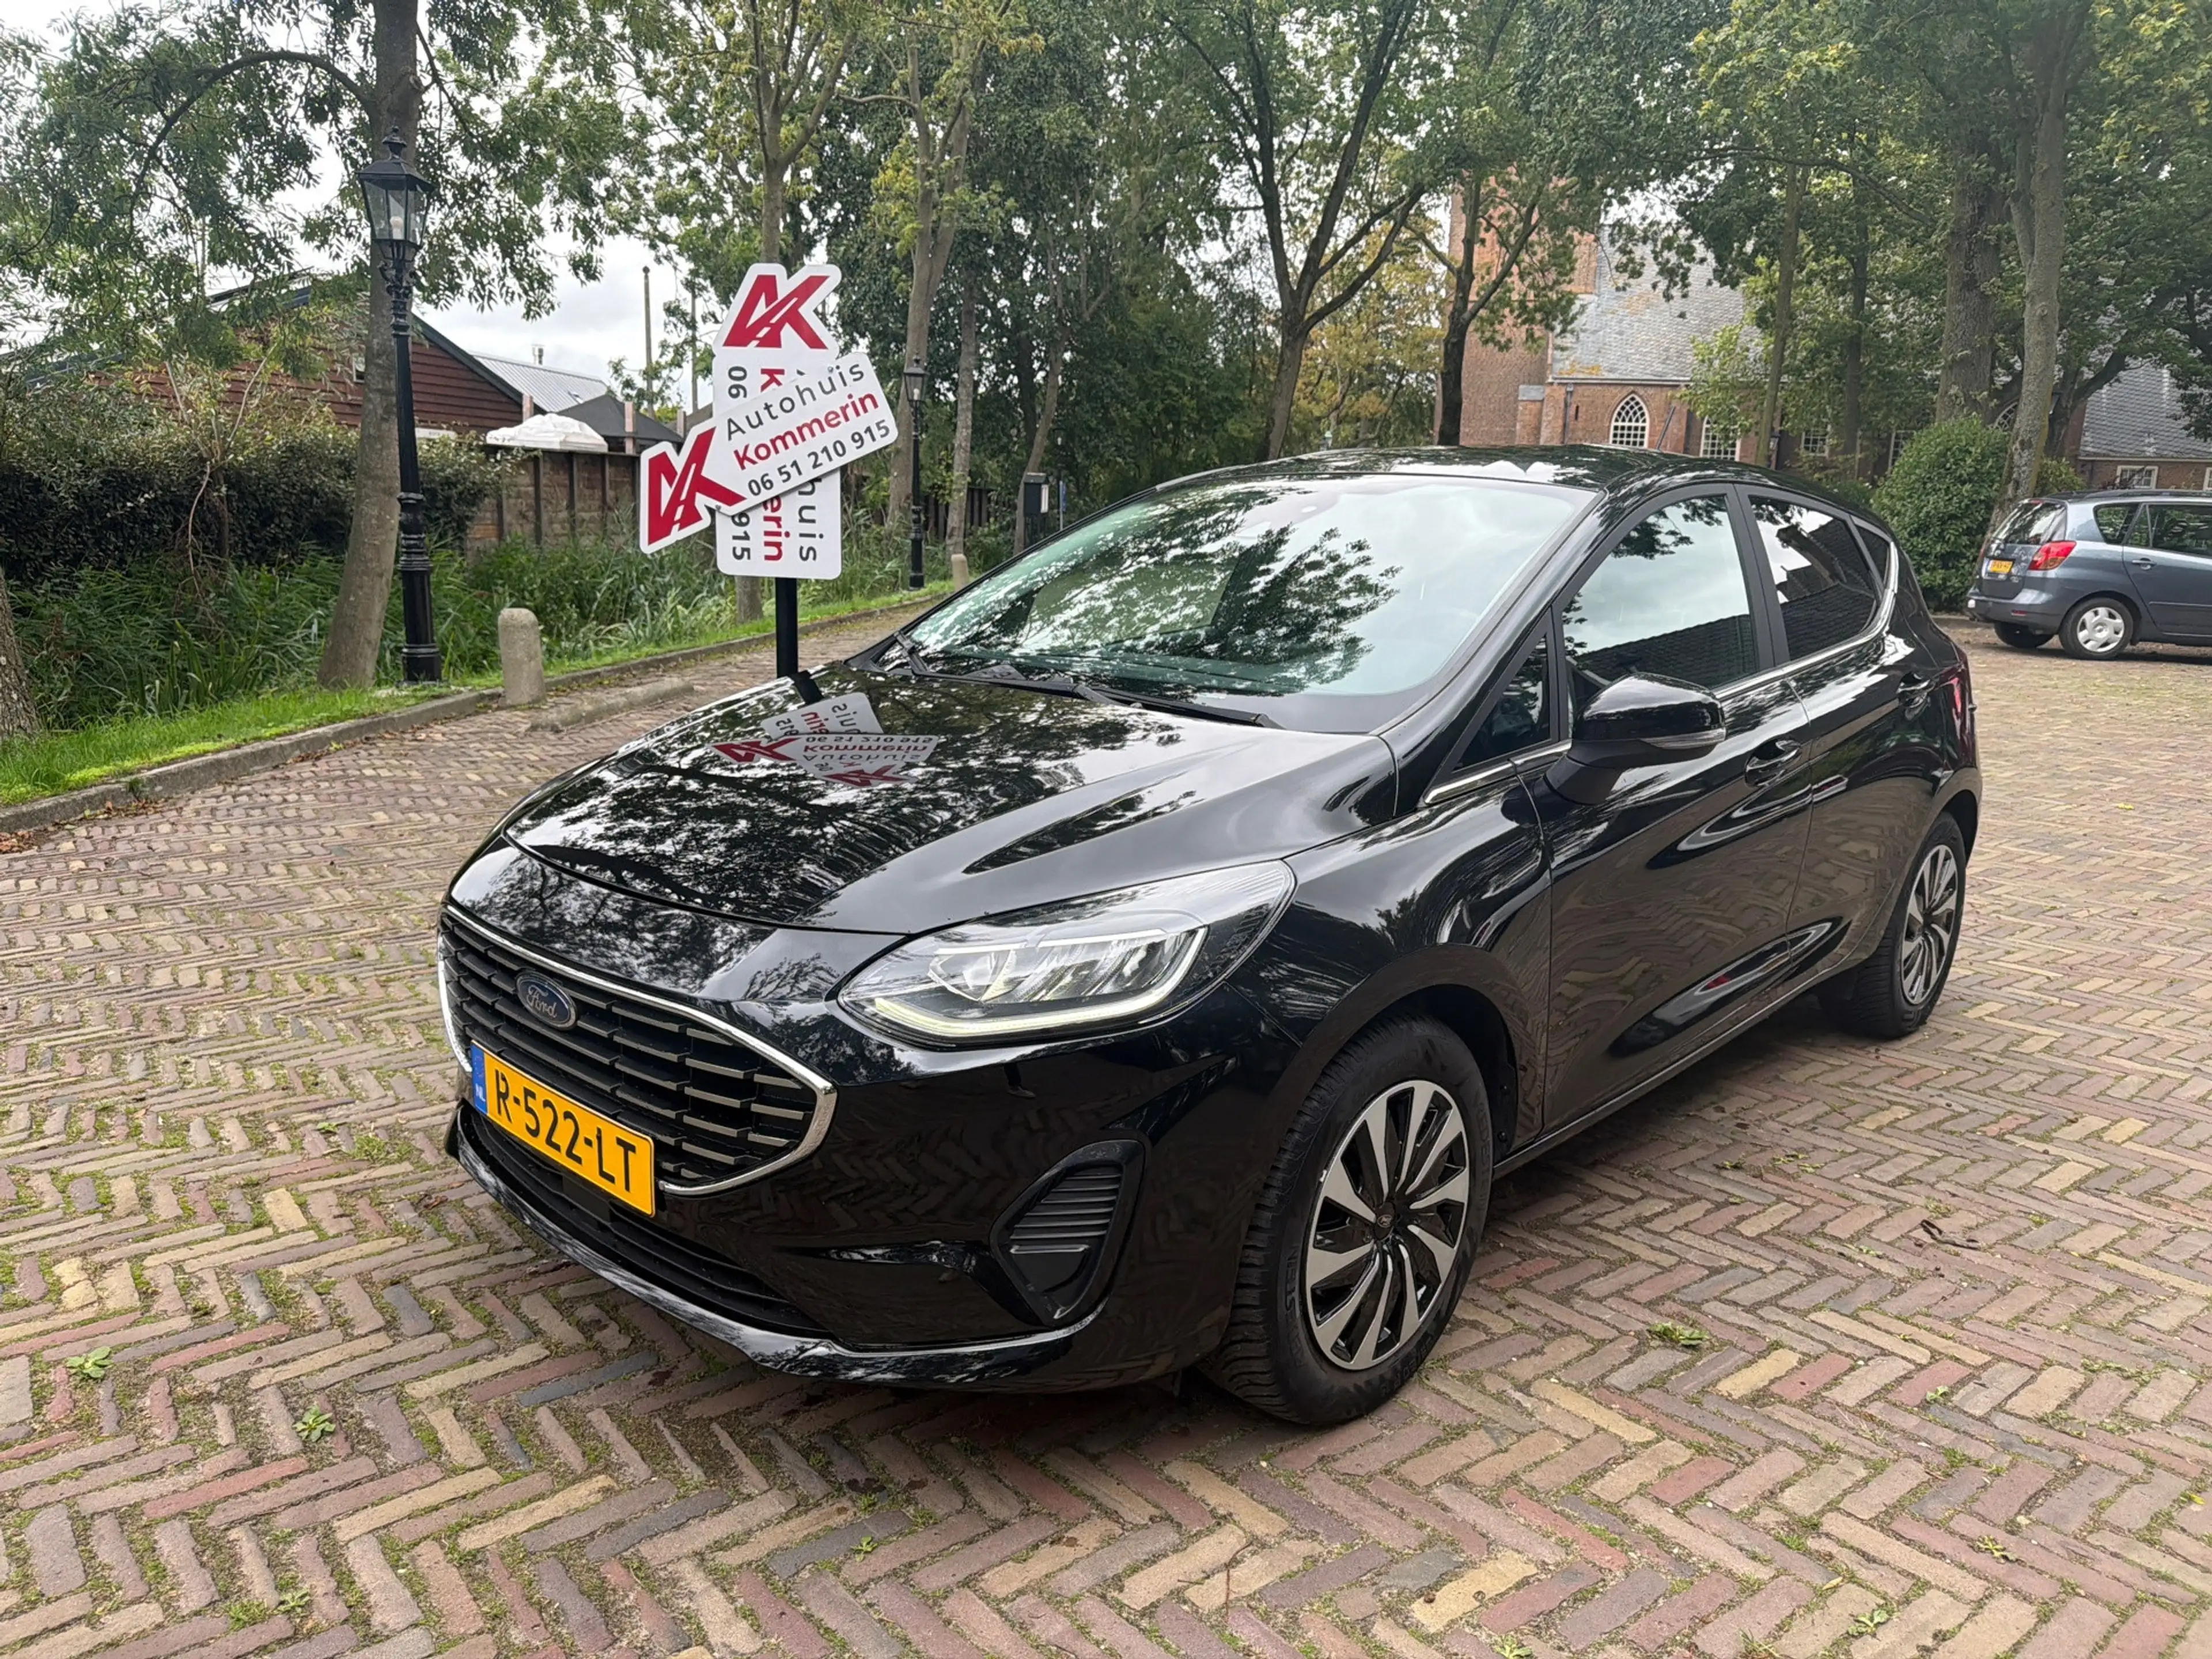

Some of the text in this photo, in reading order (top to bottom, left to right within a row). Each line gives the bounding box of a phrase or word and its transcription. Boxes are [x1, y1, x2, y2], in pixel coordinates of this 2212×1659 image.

[726, 363, 864, 441] Autohuis
[733, 392, 878, 471] Kommerin
[748, 420, 890, 497] 06 51 210 915
[527, 986, 558, 1019] Ford
[495, 1068, 637, 1194] R-522-LT
